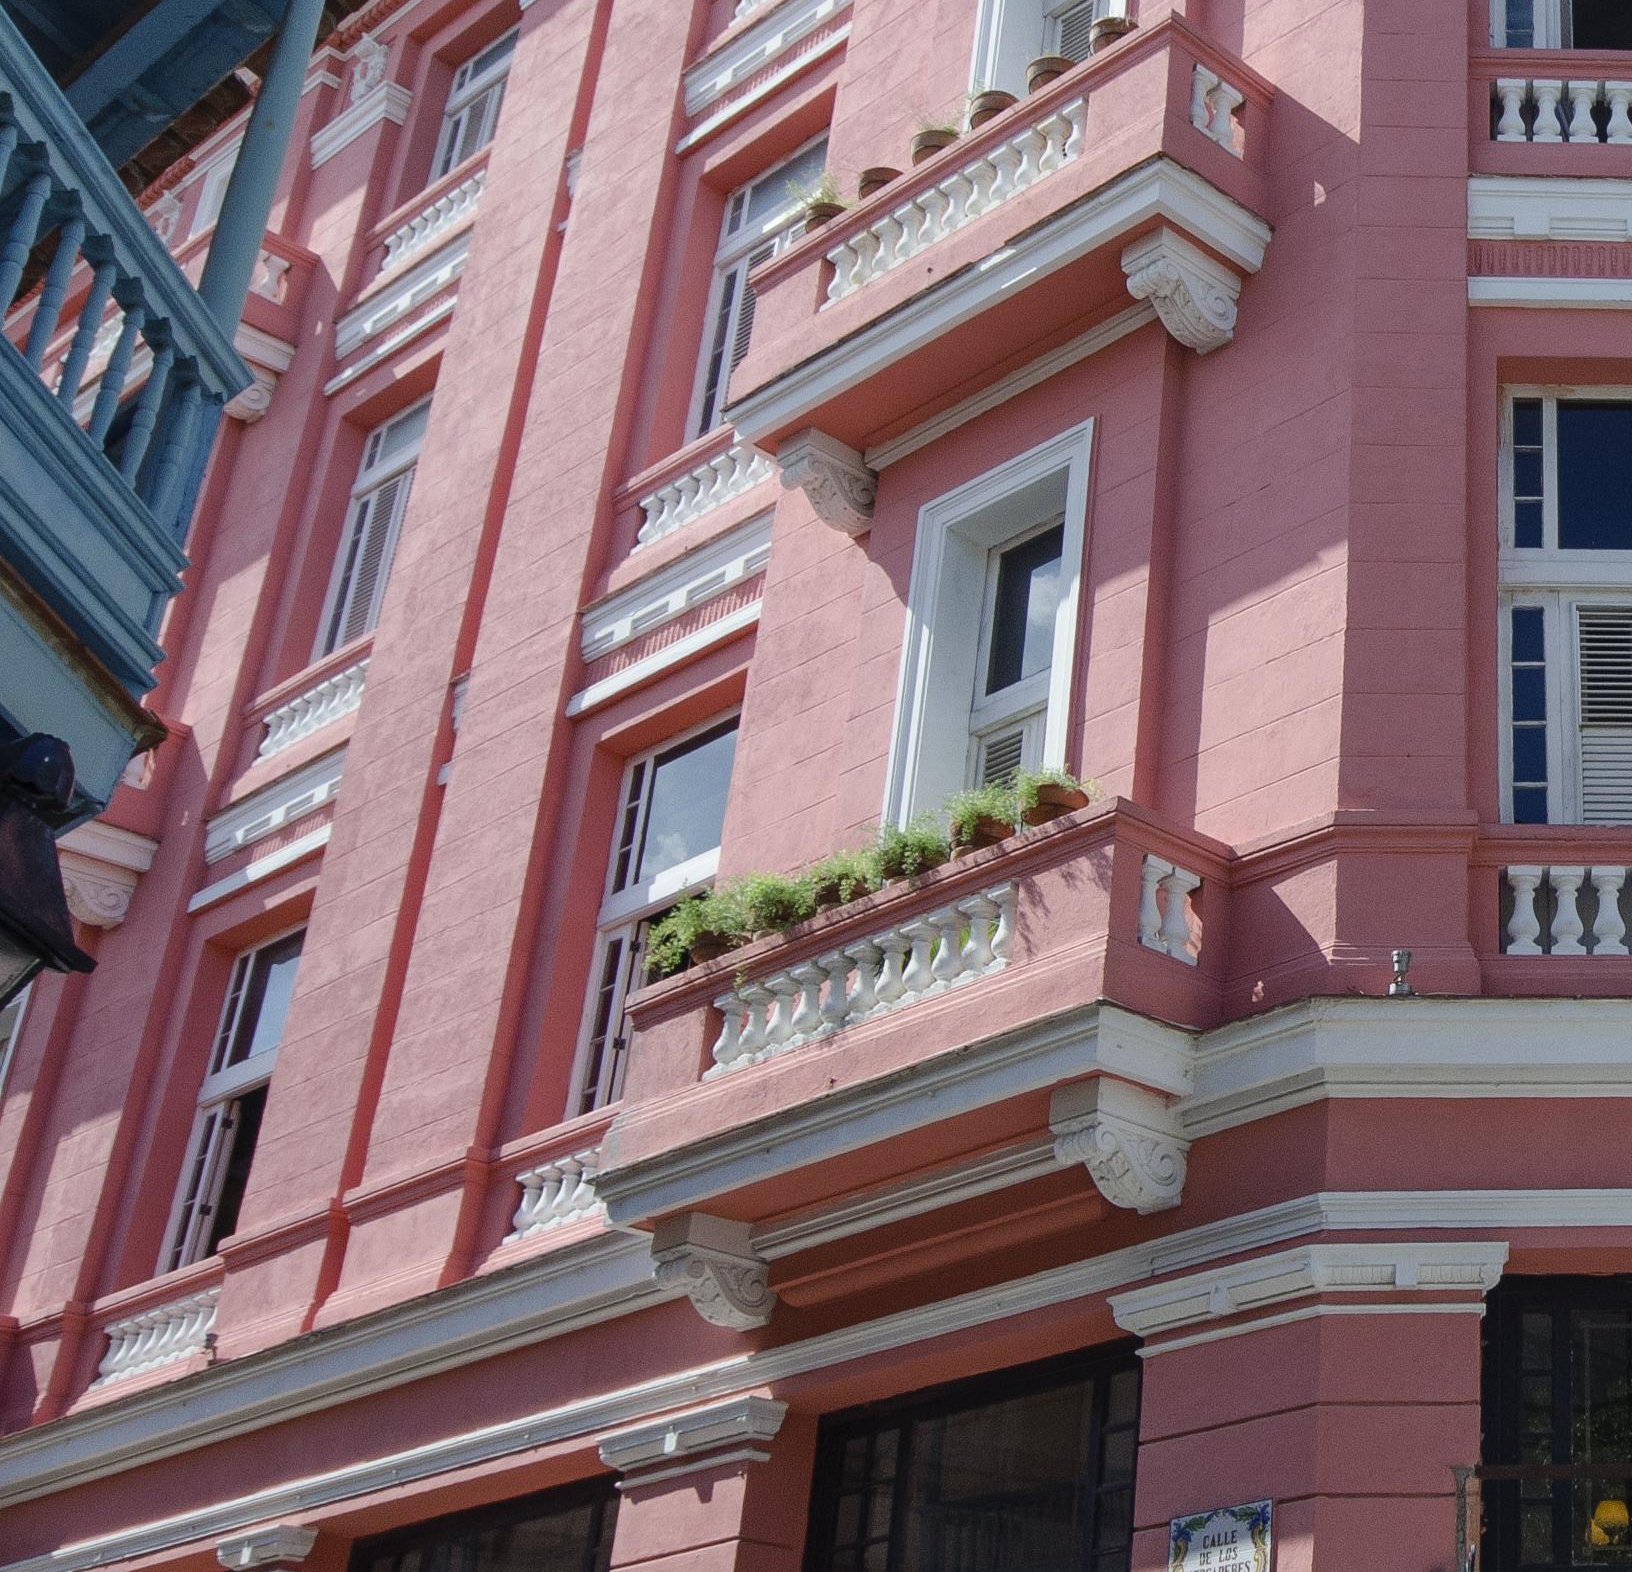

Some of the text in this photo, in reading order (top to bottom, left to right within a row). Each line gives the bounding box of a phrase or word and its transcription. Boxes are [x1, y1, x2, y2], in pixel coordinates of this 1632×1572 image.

[1203, 1530, 1238, 1549] CALLE
[1199, 1547, 1238, 1566] DE LOS
